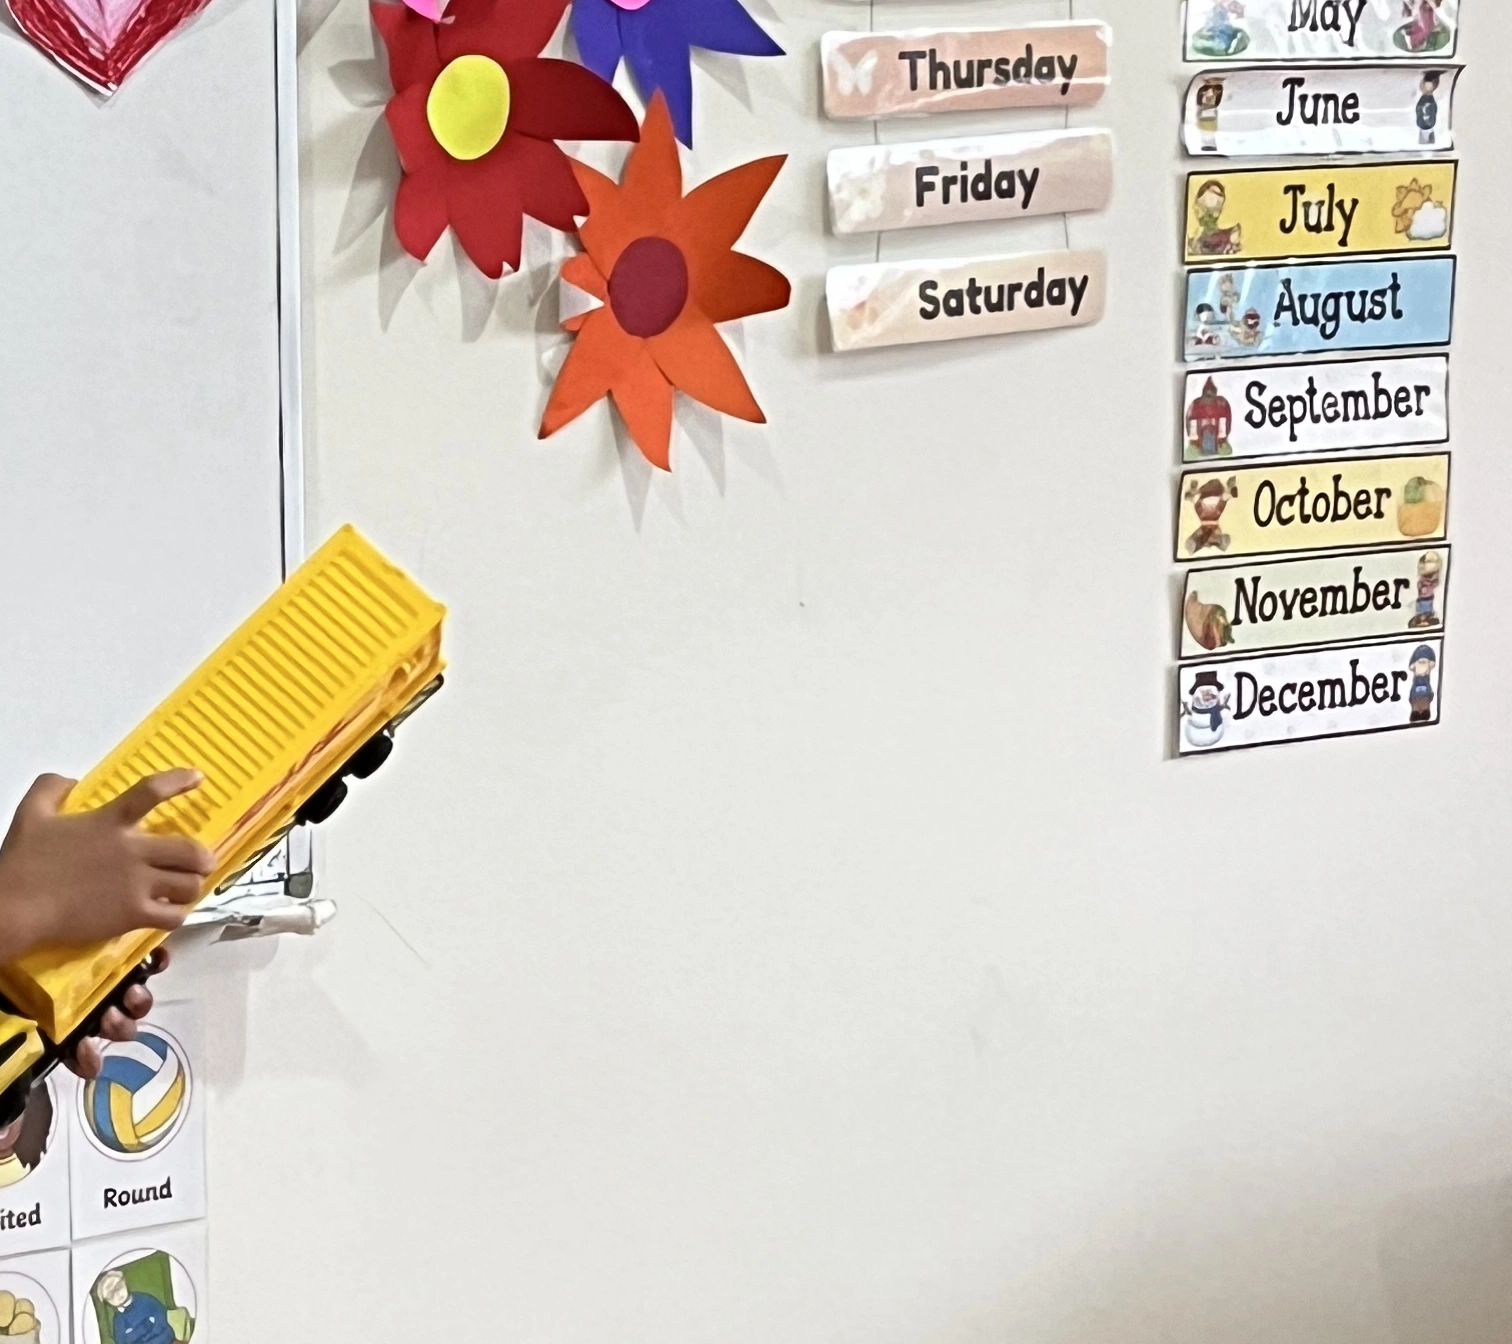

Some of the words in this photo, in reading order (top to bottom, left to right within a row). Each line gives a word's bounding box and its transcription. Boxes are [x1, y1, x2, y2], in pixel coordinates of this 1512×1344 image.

[898, 43, 1078, 96] Thursday
[1276, 77, 1361, 126] June
[915, 158, 1039, 210] Friday
[1279, 183, 1359, 247] July
[918, 267, 1089, 321] Saturday
[1273, 272, 1404, 341] August
[1244, 371, 1431, 442] September
[1253, 474, 1392, 528] October
[1231, 566, 1410, 626] November
[1232, 659, 1408, 721] December
[103, 1176, 173, 1209] Round
